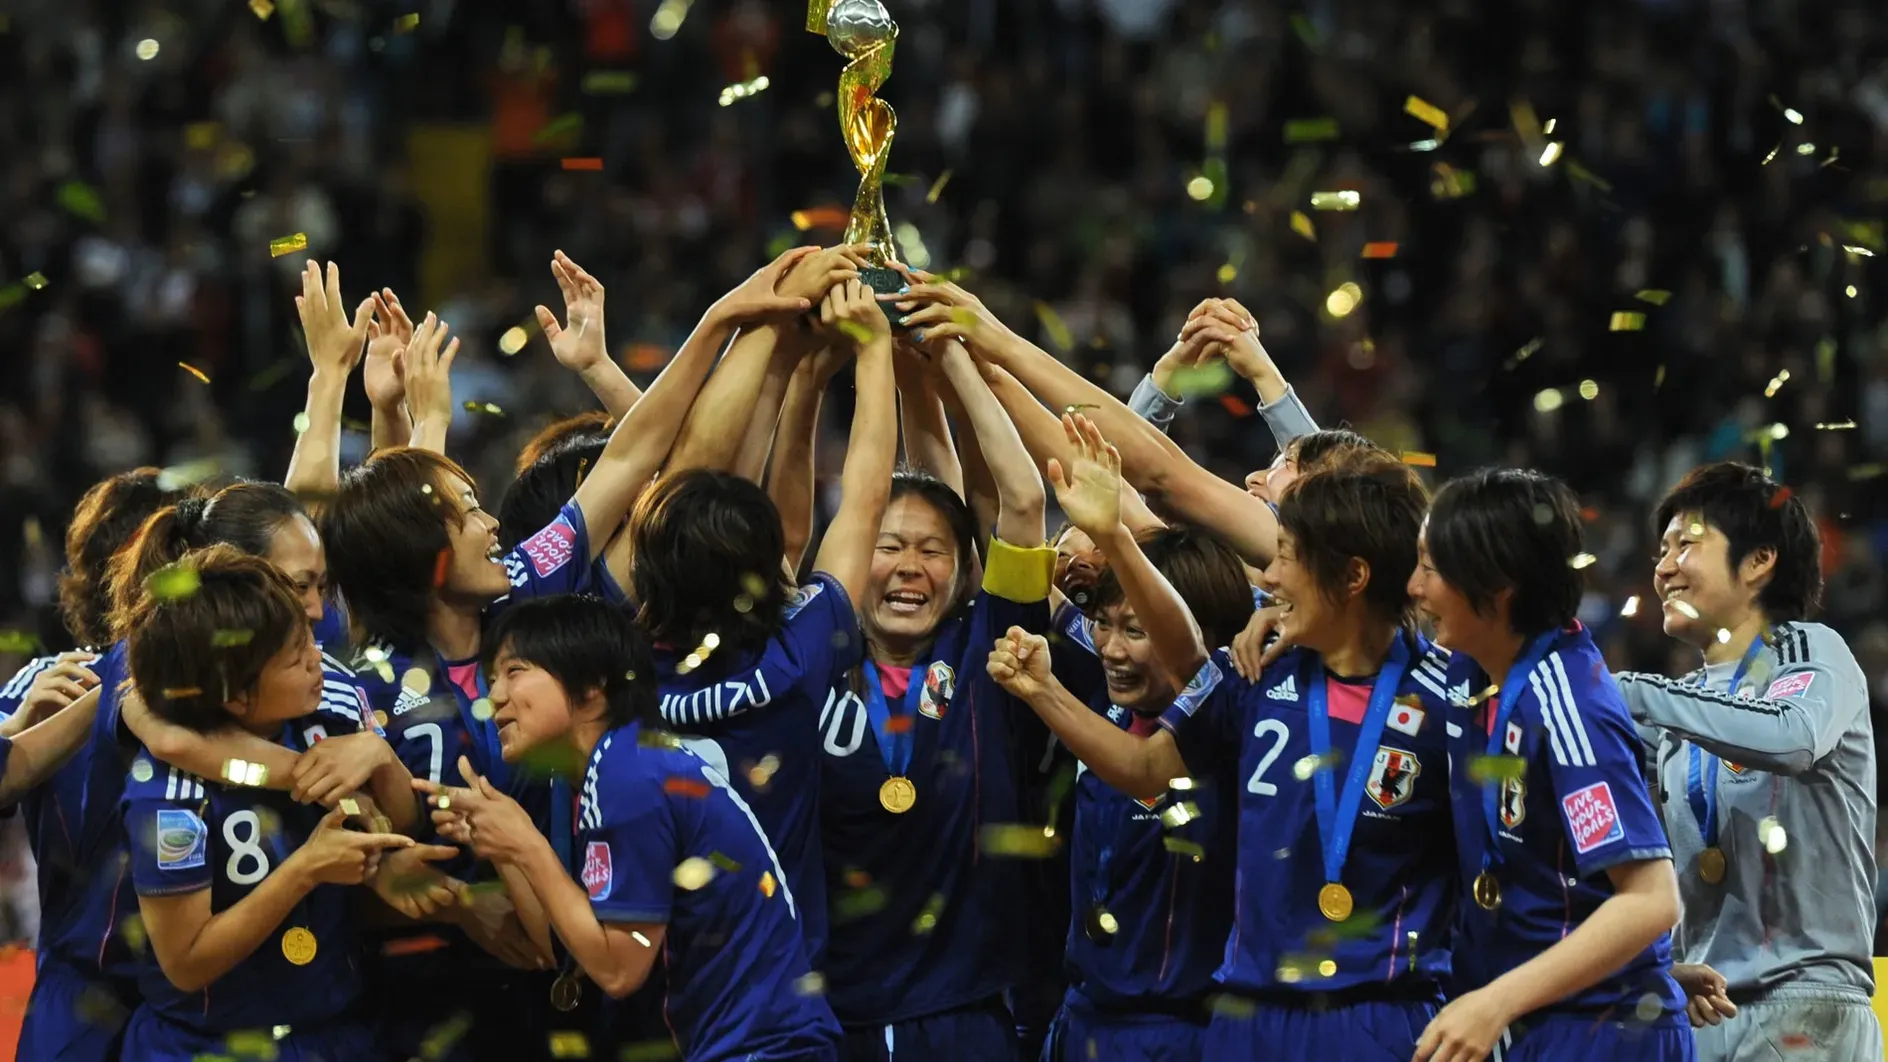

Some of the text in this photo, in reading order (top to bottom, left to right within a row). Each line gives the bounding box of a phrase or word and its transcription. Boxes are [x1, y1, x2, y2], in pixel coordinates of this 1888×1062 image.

[530, 546, 555, 570] LIVE
[535, 535, 565, 563] YOUR
[393, 696, 431, 716] adidas
[1266, 690, 1299, 702] adidas
[404, 722, 443, 784] 7
[1247, 719, 1289, 796] 2
[1131, 813, 1162, 821] JAPA
[1567, 790, 1593, 818] LIVE
[1573, 799, 1608, 831] YOUR
[1577, 808, 1614, 845] GOALS
[222, 809, 270, 885] 8
